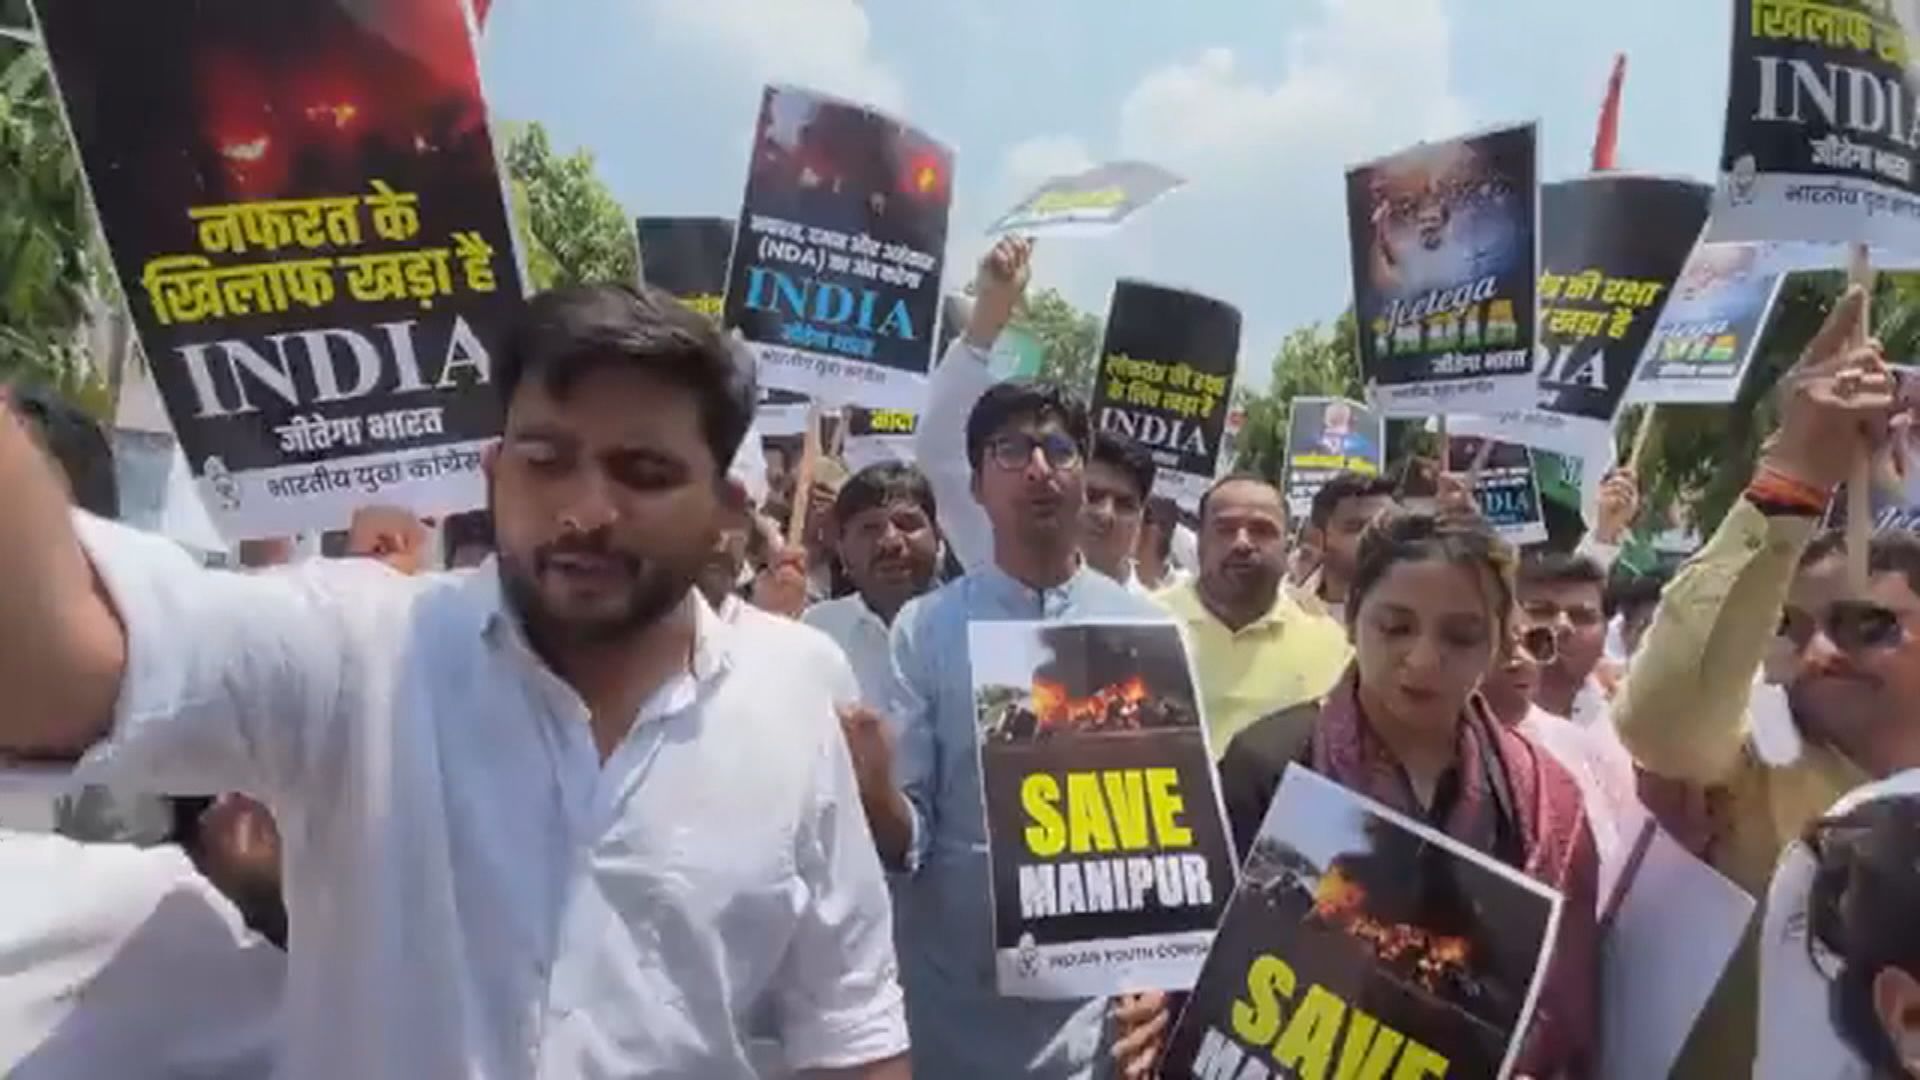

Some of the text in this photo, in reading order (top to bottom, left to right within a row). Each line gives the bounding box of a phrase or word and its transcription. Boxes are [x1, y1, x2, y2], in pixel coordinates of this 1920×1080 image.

[188, 178, 420, 254] नफरत के
[141, 231, 497, 325] खिलाफ खड़ा है
[758, 235, 826, 273] (NDA)
[745, 265, 917, 340] INDIA
[172, 312, 491, 419] INDIA
[274, 407, 445, 455] जीतेगा भारत
[1100, 406, 1208, 456] INDIA
[267, 466, 350, 500] भारतीय
[352, 461, 401, 494] युवा
[1486, 491, 1530, 513] DIA
[1020, 767, 1193, 858] SAVE
[1018, 853, 1213, 920] MANIPUR
